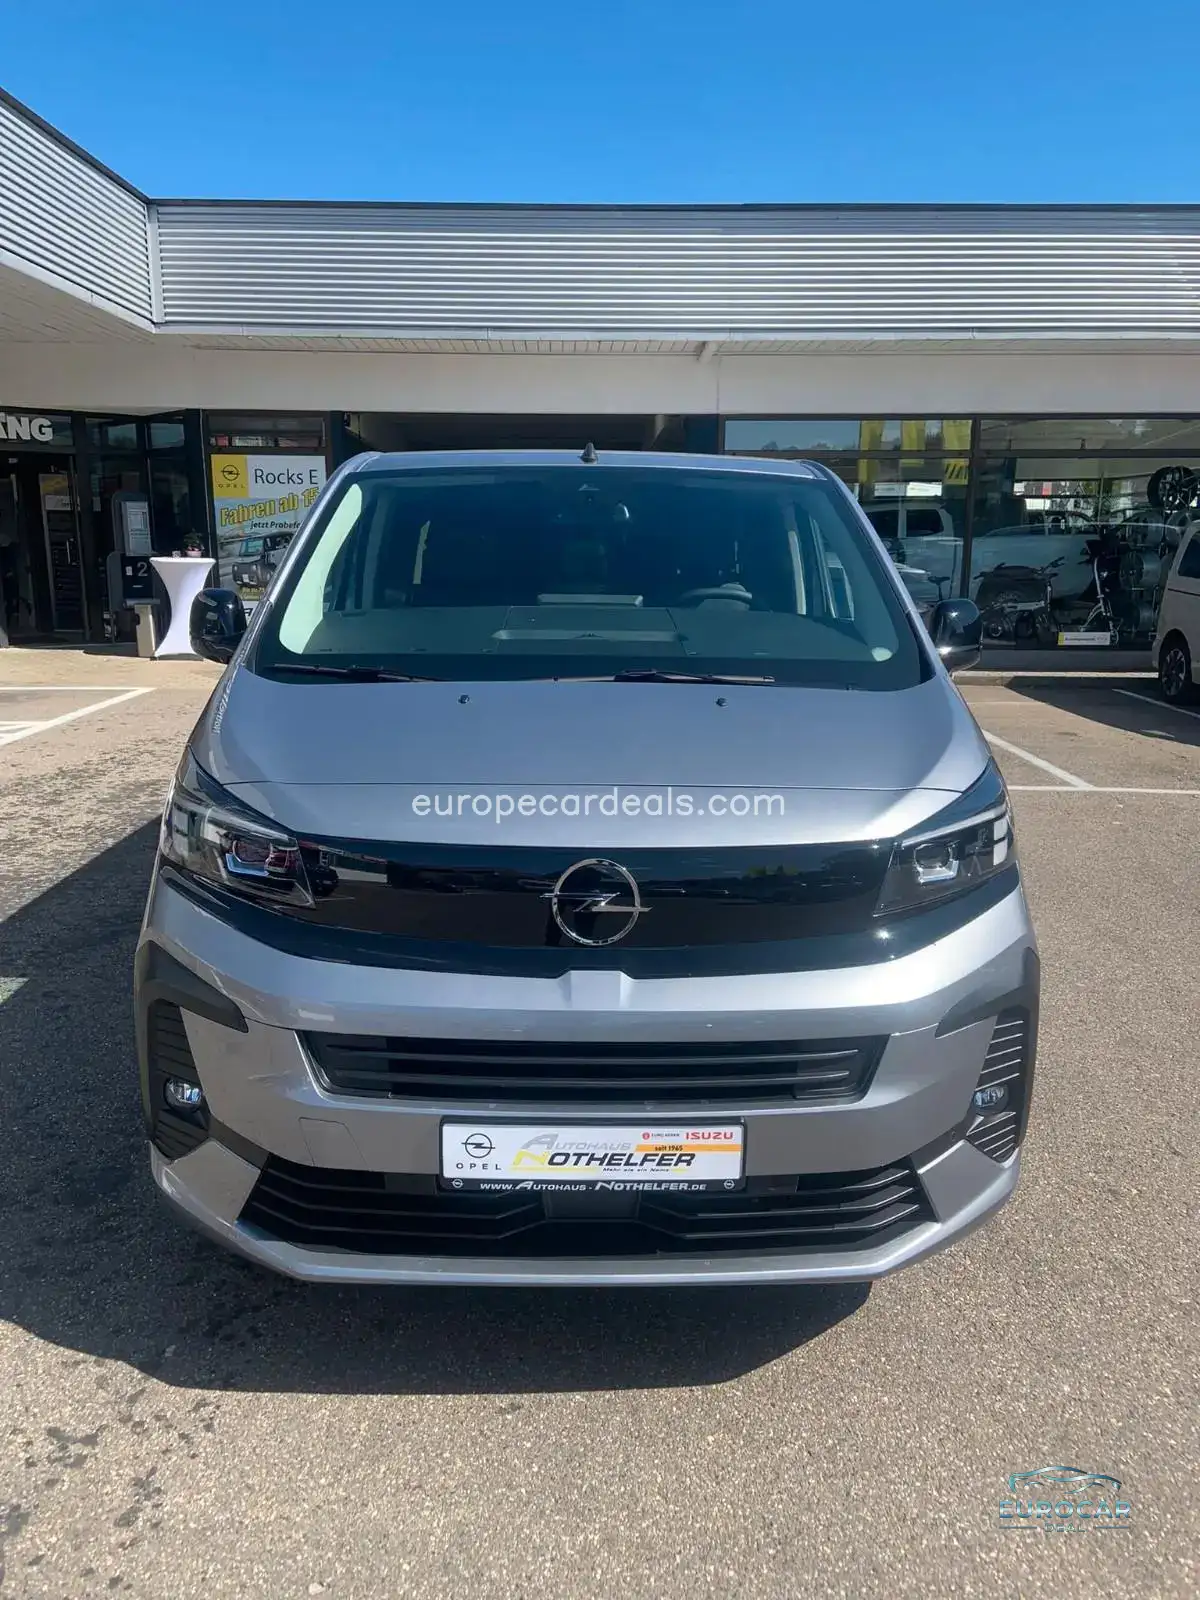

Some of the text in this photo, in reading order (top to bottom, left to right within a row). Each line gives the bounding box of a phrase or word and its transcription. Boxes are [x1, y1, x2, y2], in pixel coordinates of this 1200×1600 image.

[254, 468, 318, 485] Rocks E
[220, 499, 276, 527] Fahren
[278, 492, 299, 513] ab
[250, 521, 269, 530] jetzt
[137, 561, 148, 577] 2
[520, 1132, 632, 1151] AUTOHAUS
[685, 1132, 734, 1140] ISUZU
[512, 1149, 696, 1167] NOTHELFER
[456, 1163, 501, 1171] OPEL
